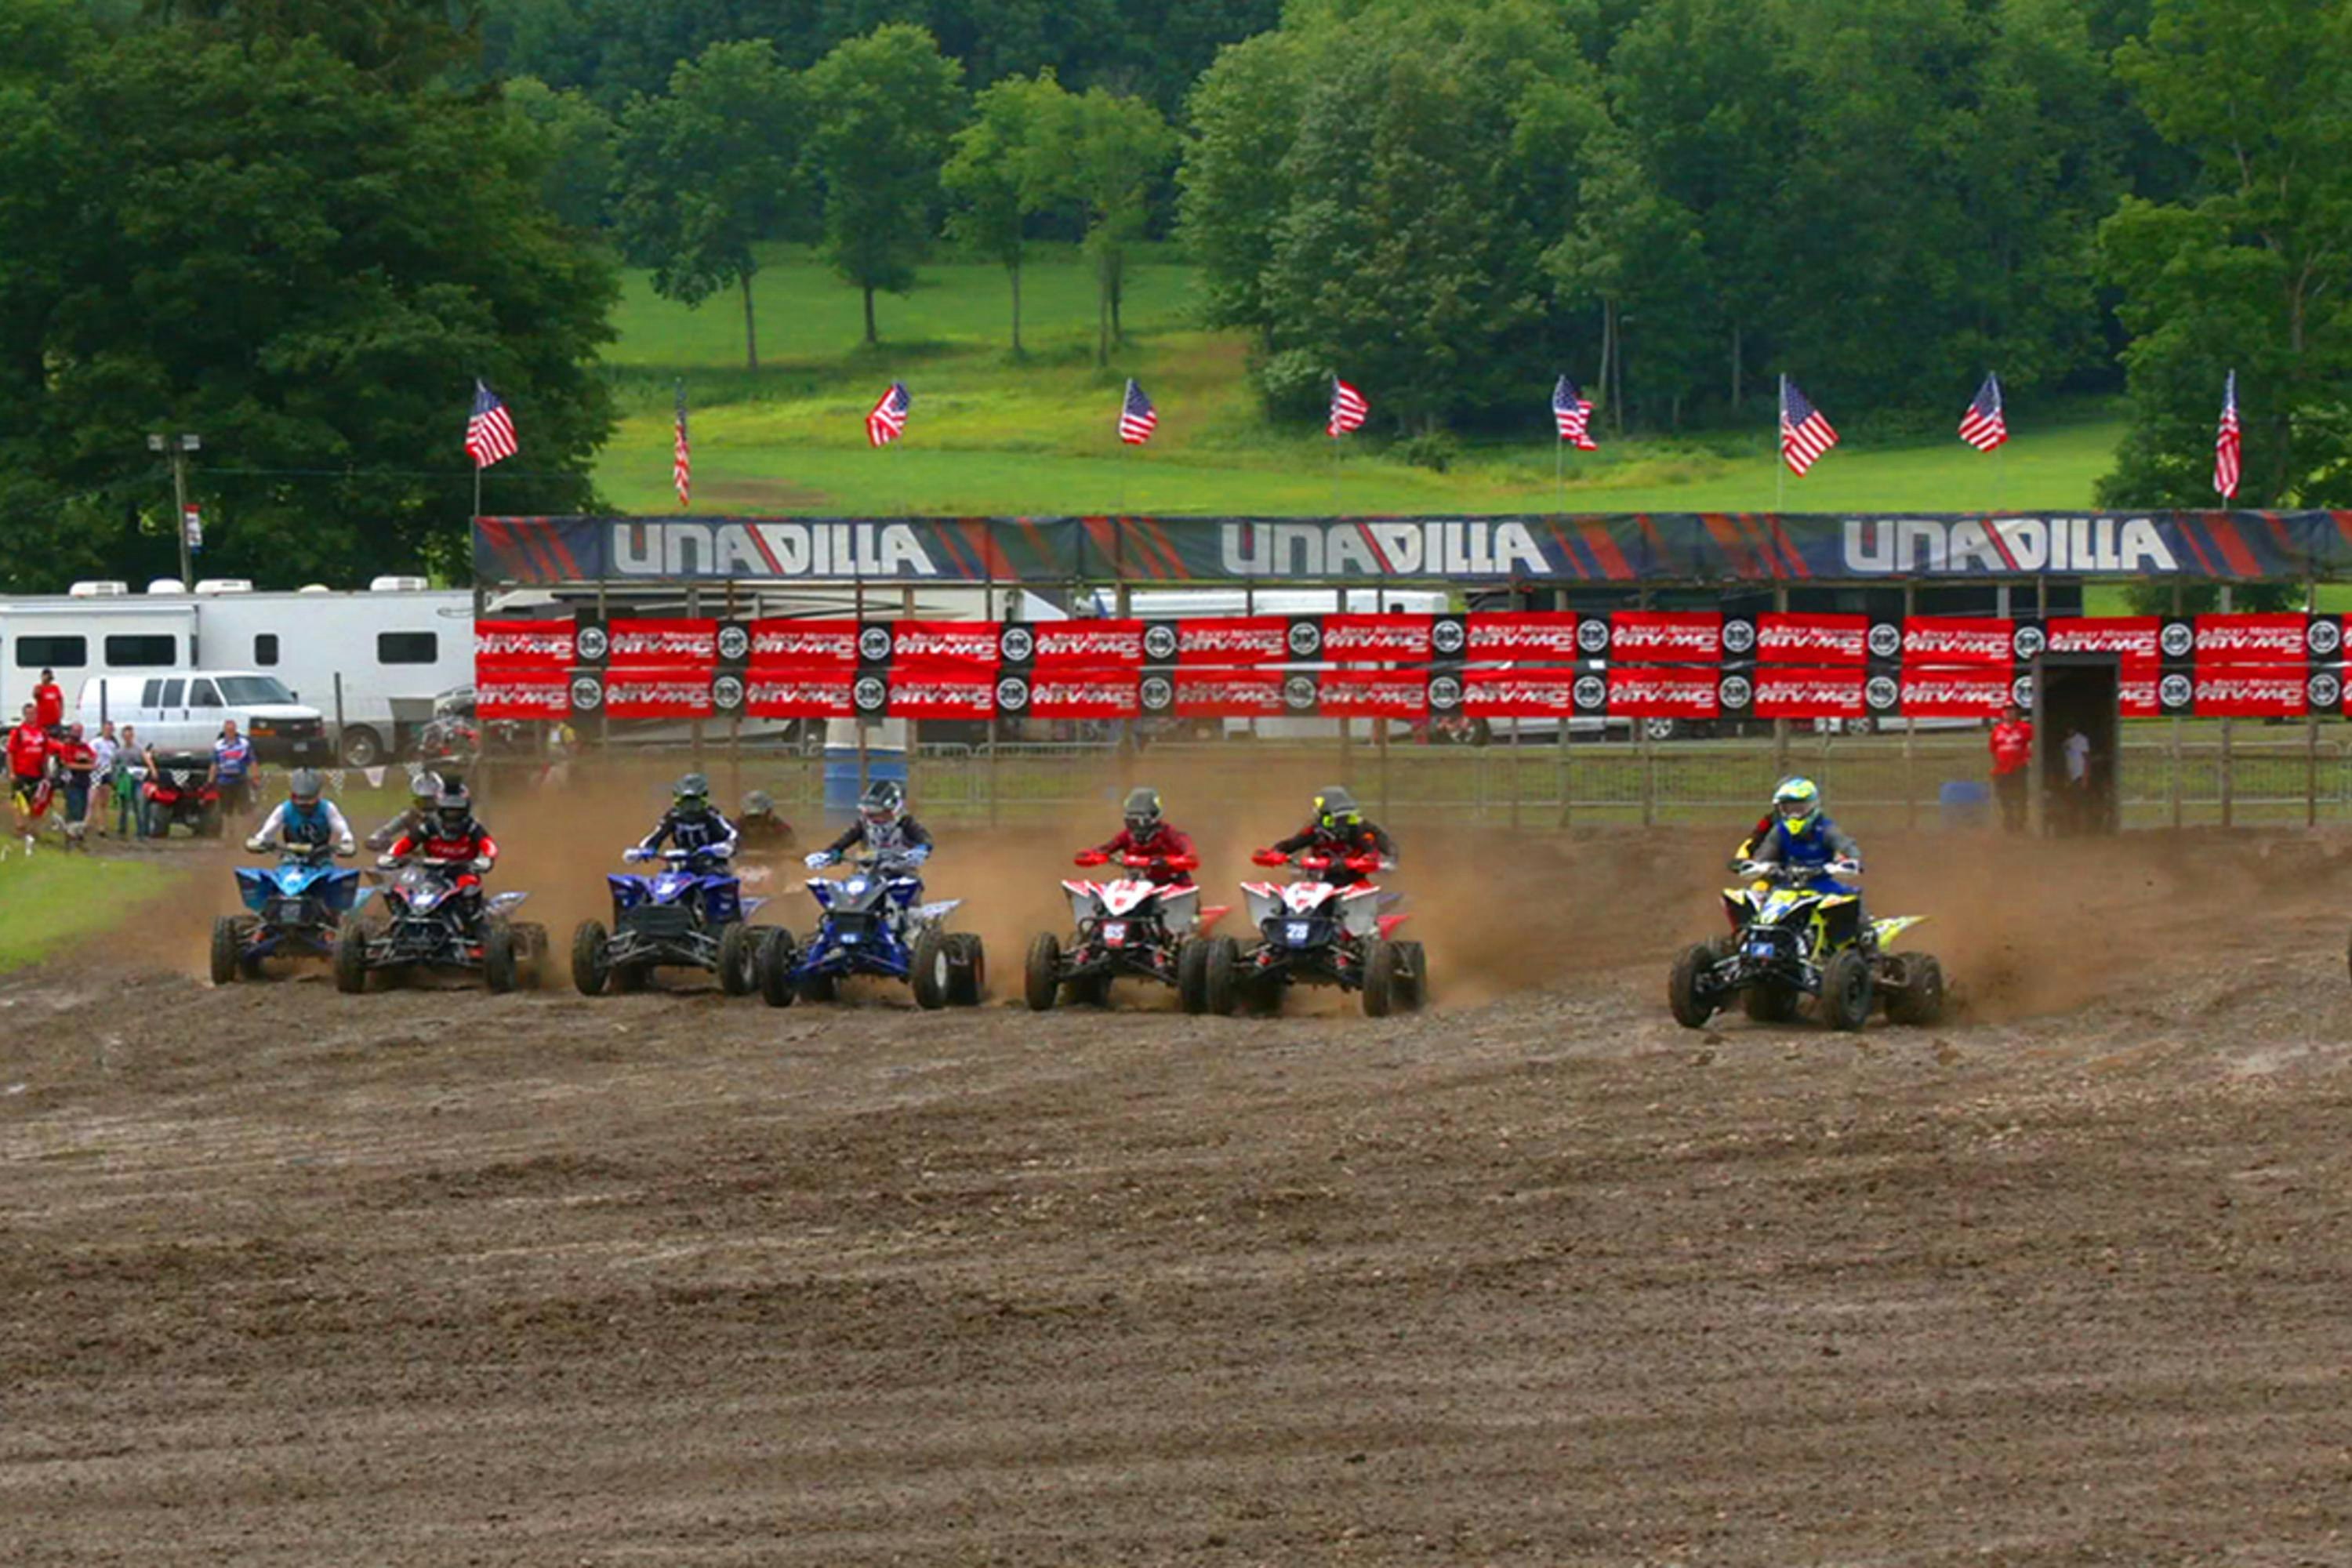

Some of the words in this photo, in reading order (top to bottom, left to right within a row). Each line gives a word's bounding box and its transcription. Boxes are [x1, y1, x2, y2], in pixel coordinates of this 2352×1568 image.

[614, 523, 937, 575] UNADILLA
[1221, 522, 1552, 574] UNADILLA
[1843, 518, 2179, 572] UNADILLA
